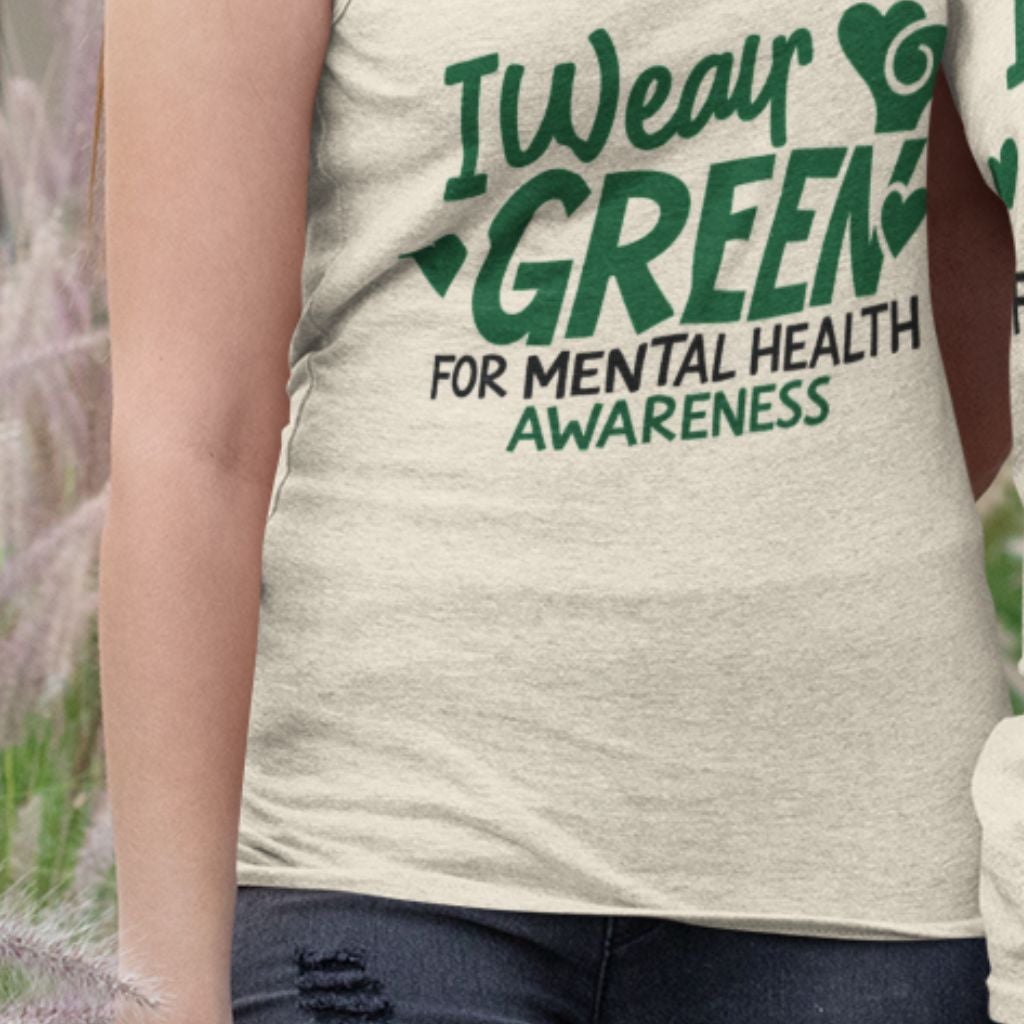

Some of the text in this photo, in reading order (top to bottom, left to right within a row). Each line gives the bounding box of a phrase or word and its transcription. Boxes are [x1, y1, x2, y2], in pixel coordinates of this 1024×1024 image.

[444, 52, 499, 202] I
[472, 137, 927, 345] GREEN
[430, 295, 920, 399] FOR MENTAL HEALTH
[505, 376, 831, 452] AWARENESS
